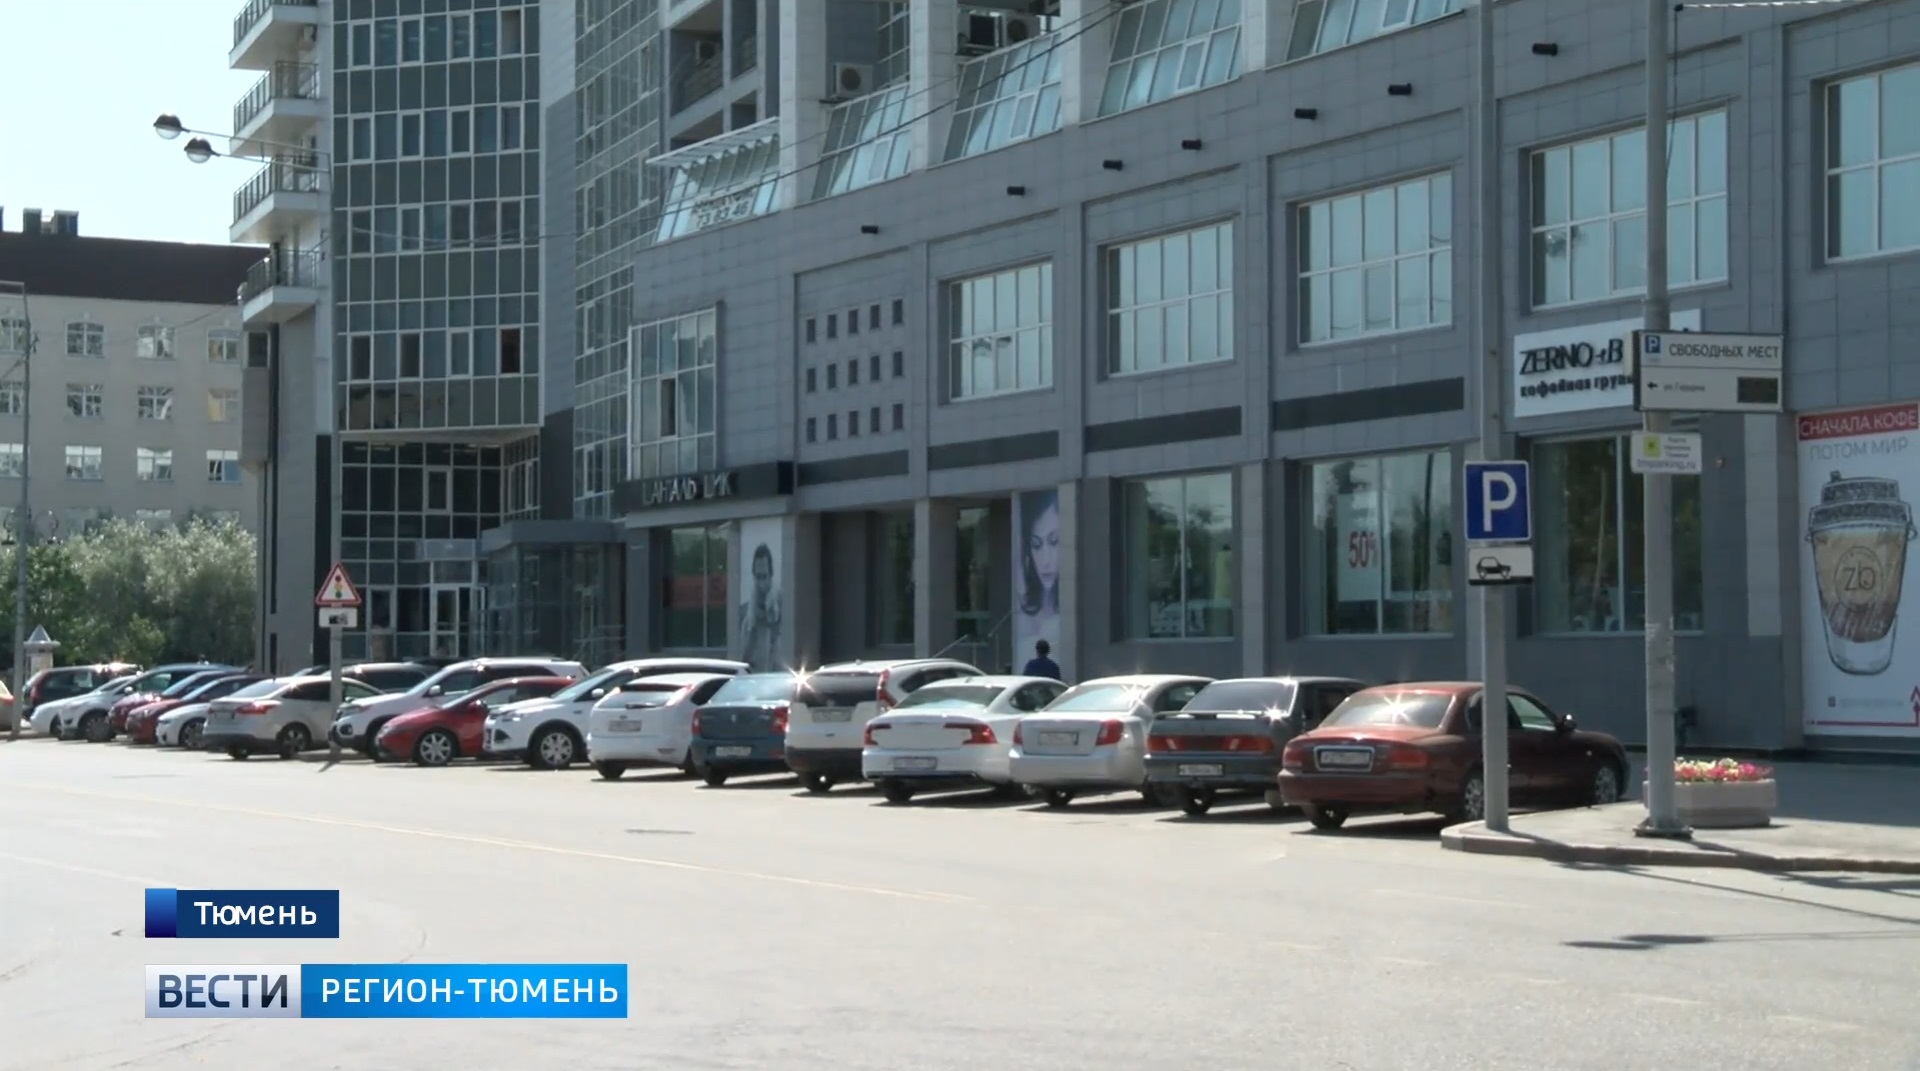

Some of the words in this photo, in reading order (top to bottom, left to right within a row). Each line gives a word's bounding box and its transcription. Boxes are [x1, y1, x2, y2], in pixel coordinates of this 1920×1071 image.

[1648, 336, 1659, 352] P
[1668, 343, 1744, 359] СВОБОДНЫХ
[1747, 345, 1780, 359] МЕСТ
[1520, 377, 1591, 398] кофейная
[1800, 414, 1871, 438] СНАЧАЛА
[1873, 409, 1918, 429] КОФЕ
[1809, 441, 1868, 460] ПОТОМ
[1870, 436, 1909, 455] МИР
[1482, 470, 1518, 532] P
